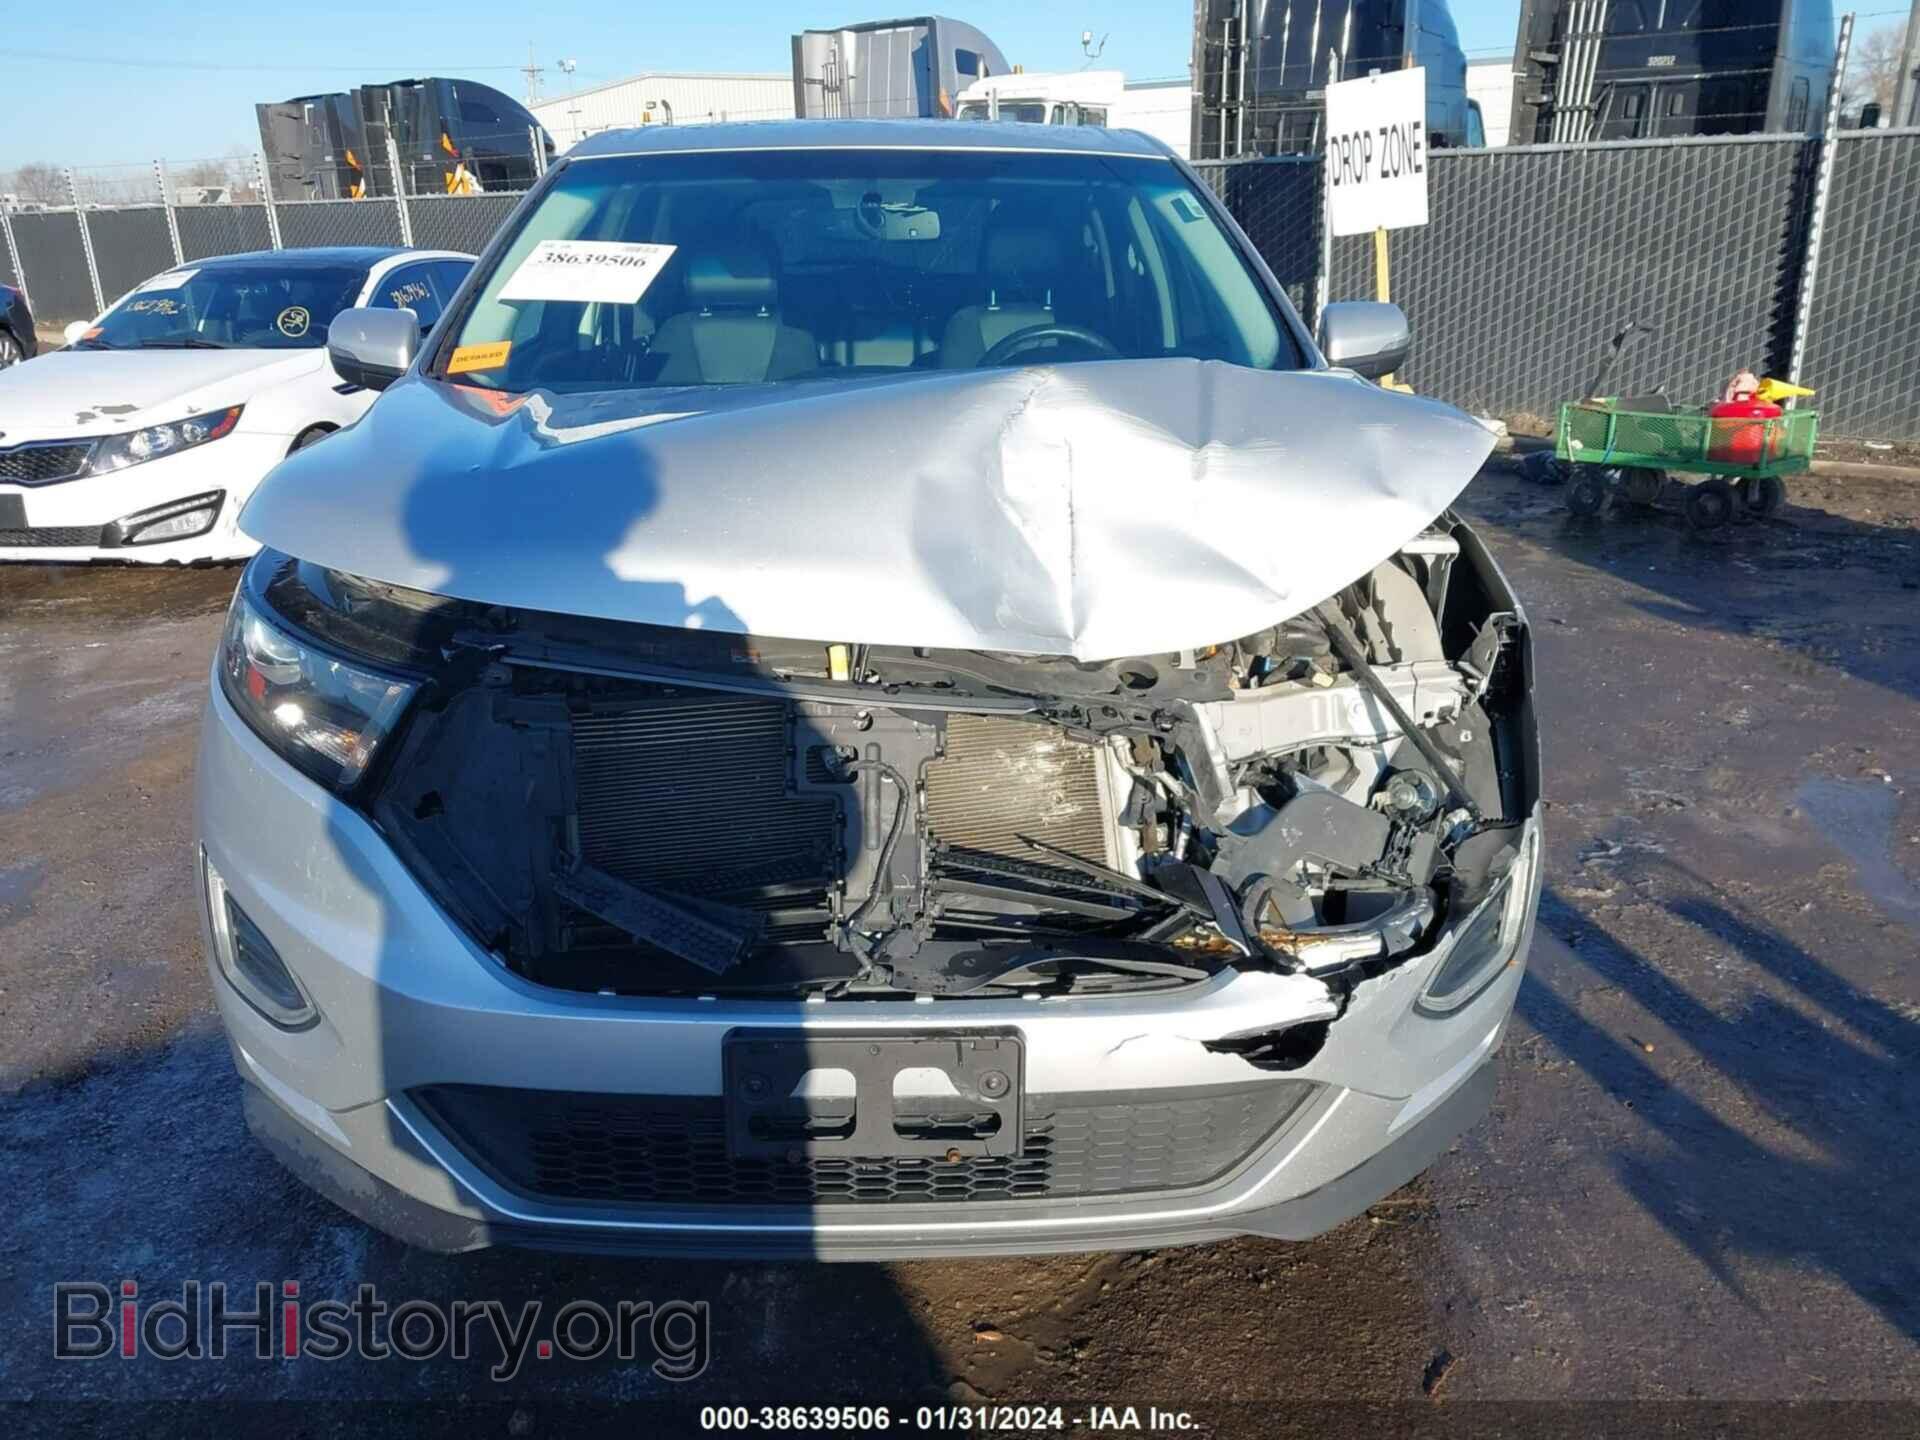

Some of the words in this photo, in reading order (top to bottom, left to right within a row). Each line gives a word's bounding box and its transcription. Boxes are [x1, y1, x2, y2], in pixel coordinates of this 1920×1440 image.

[1330, 129, 1373, 186] DROP
[1379, 121, 1423, 179] ZONE
[538, 251, 647, 268] 38639506
